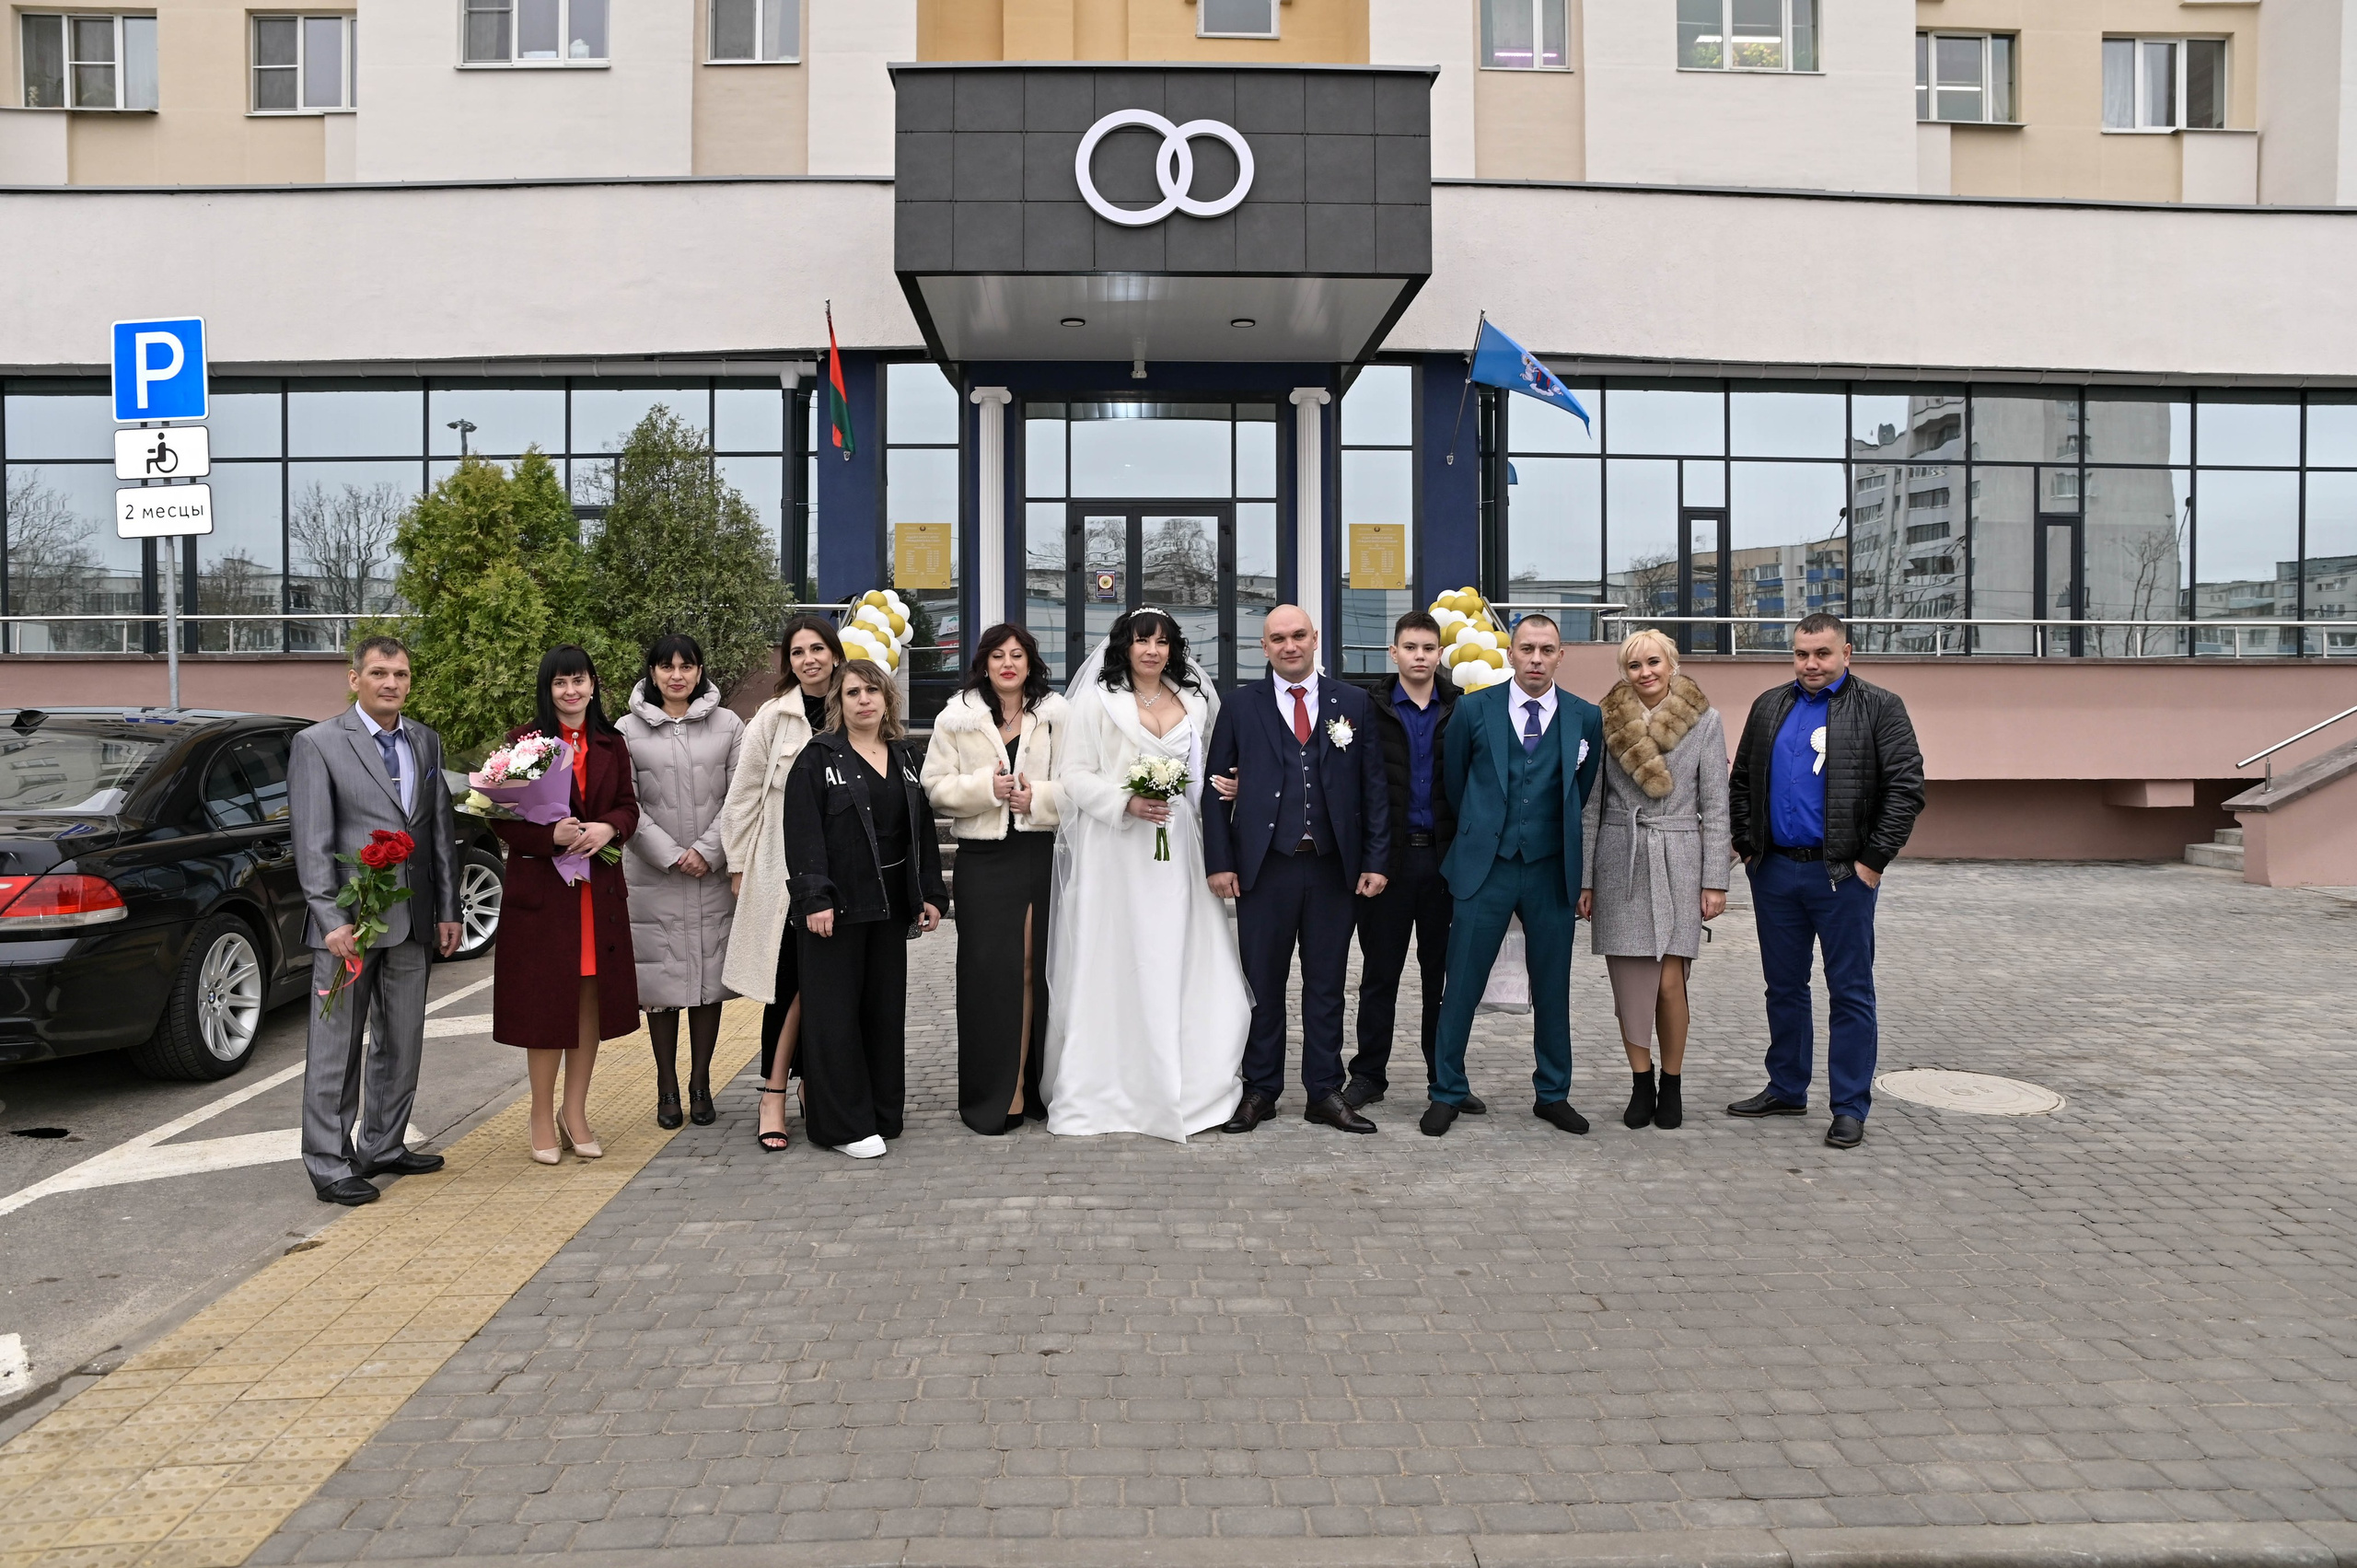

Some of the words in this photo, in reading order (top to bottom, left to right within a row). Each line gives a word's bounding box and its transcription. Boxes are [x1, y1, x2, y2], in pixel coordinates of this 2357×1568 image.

[135, 331, 184, 409] P
[125, 505, 134, 519] 2
[143, 505, 203, 518] месцы
